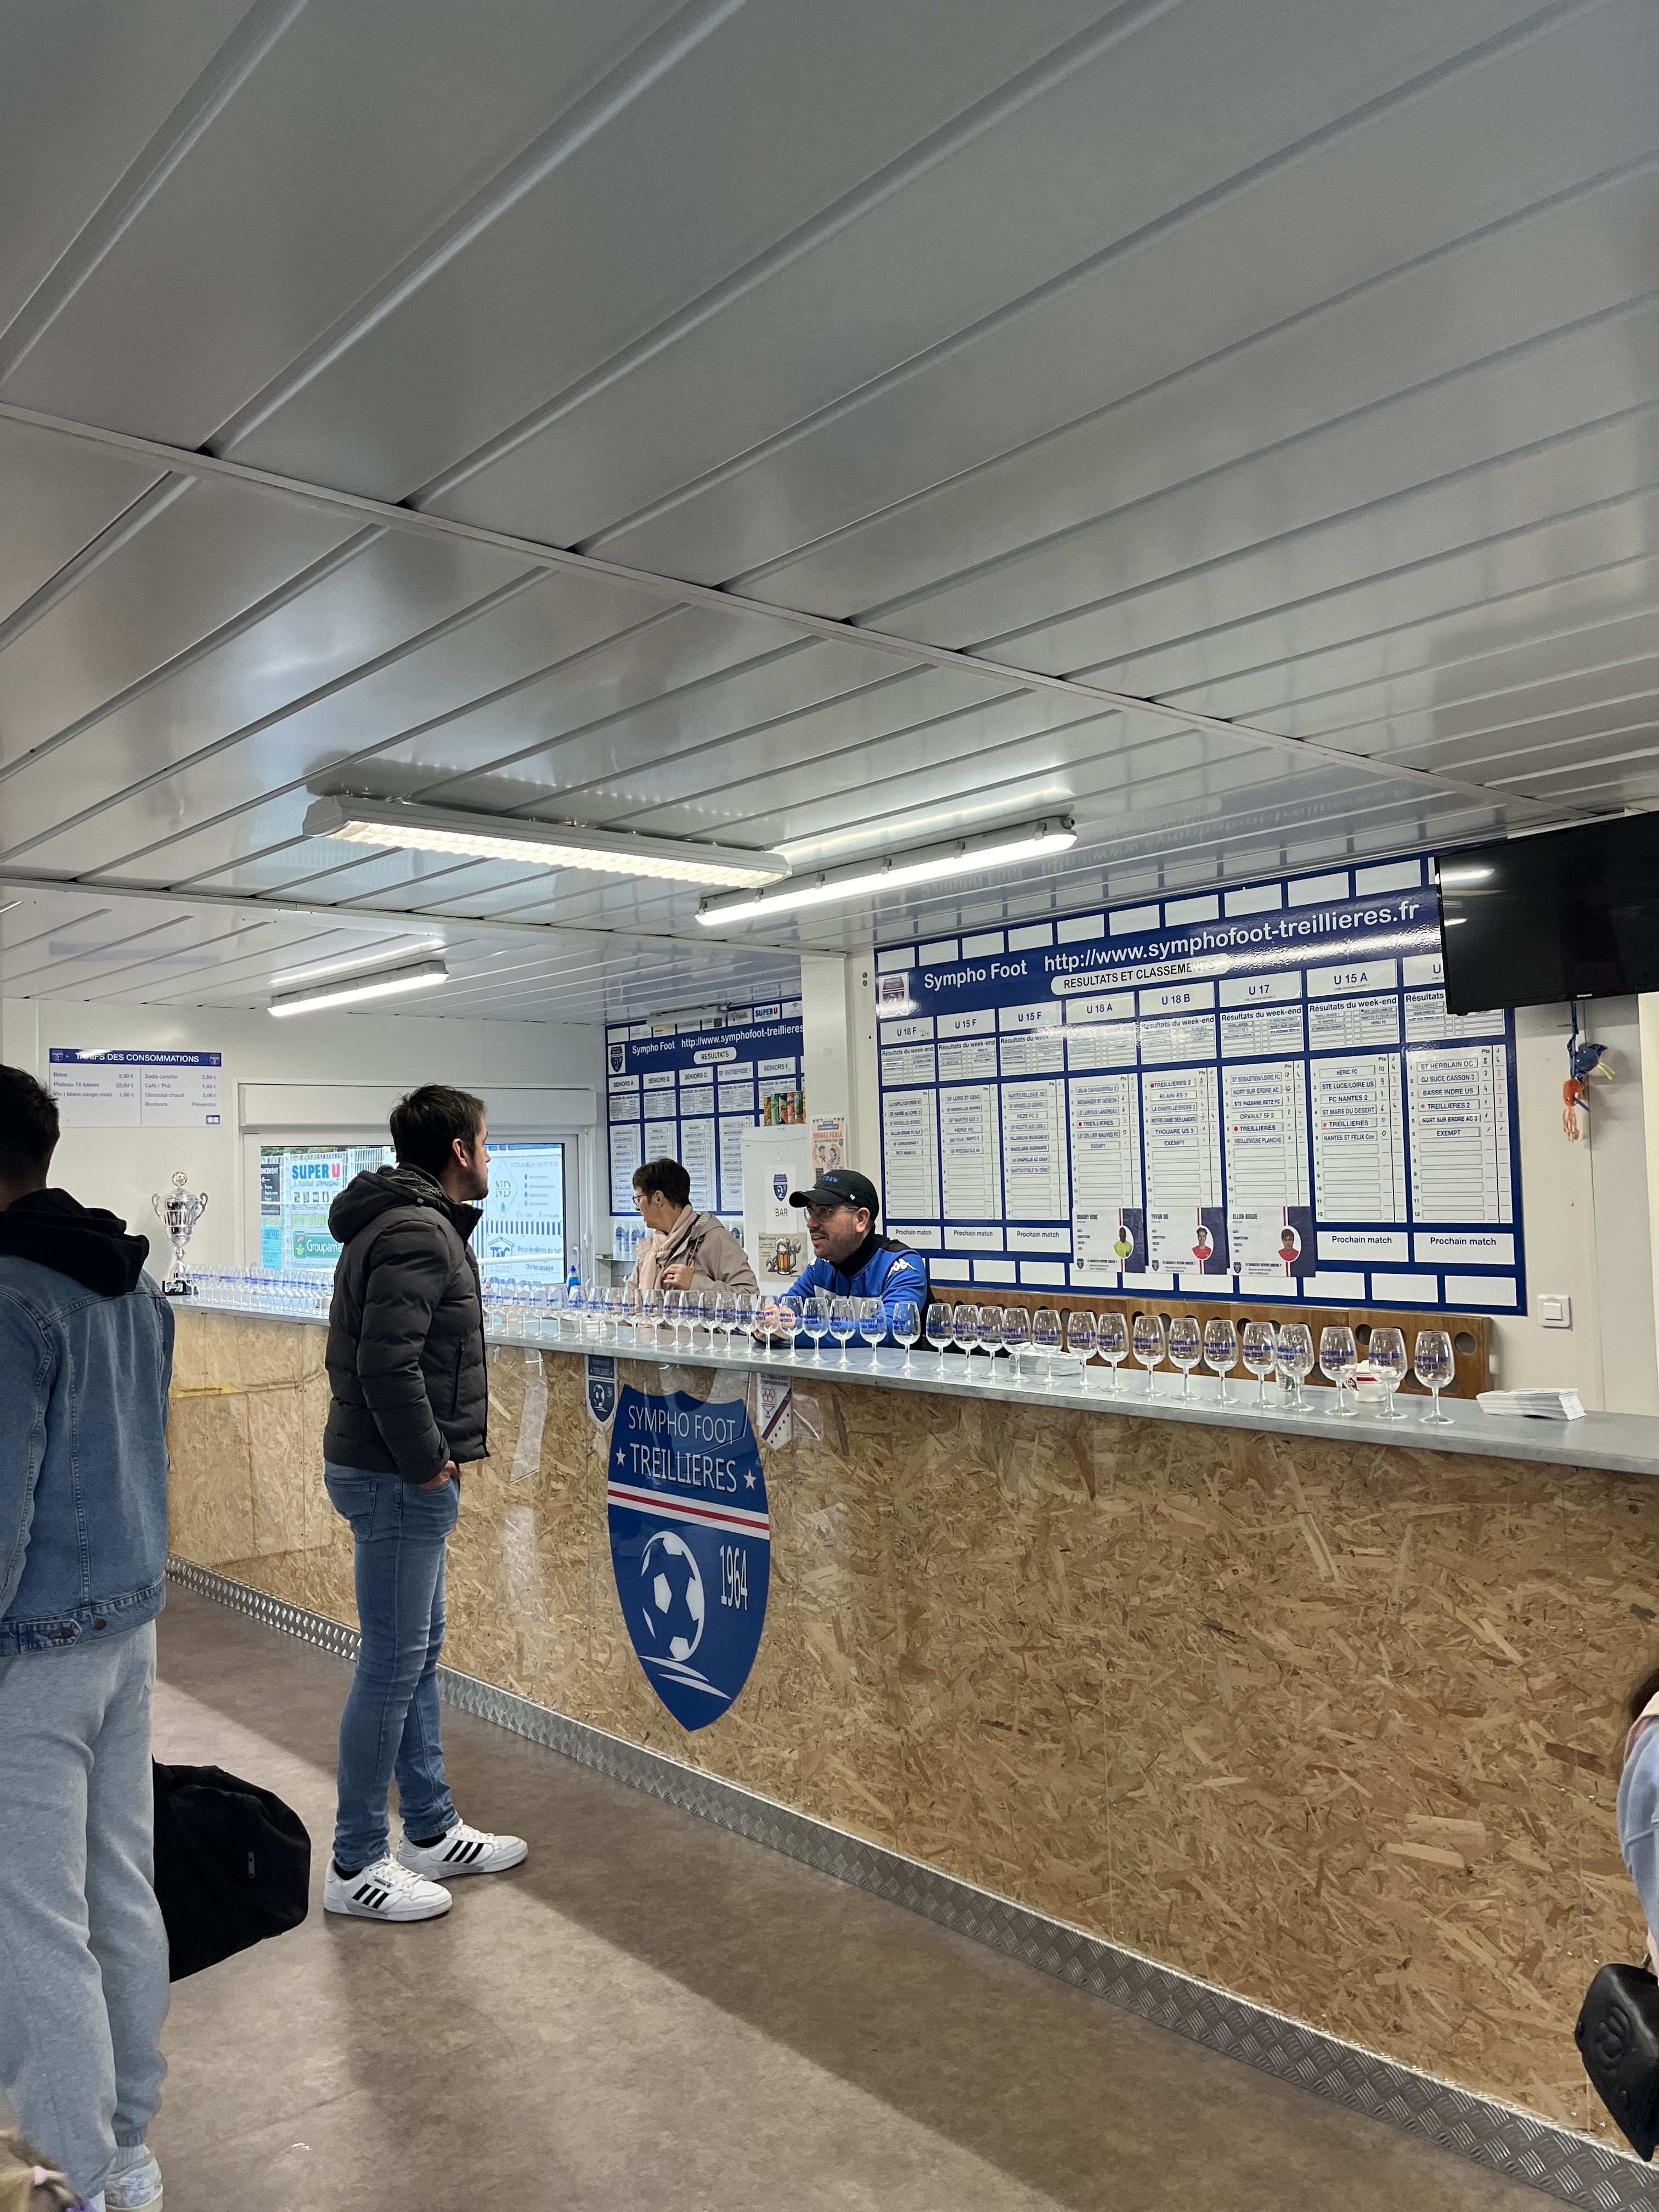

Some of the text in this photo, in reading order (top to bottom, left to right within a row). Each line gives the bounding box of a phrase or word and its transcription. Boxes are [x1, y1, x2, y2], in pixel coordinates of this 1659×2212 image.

[924, 900, 1420, 991] Sympho Foot http://www.symphofoot-treillieres.fr
[1064, 960, 1213, 989] RESULTATS ET CLASSEME
[1334, 973, 1367, 984] U 15 A
[1249, 985, 1269, 995] U 17
[1171, 995, 1181, 1003] 18
[1406, 993, 1444, 1002] Résultats
[1310, 1003, 1344, 1012] Résultats
[1358, 997, 1397, 1007] week-end
[755, 1008, 772, 1017] SUPER
[1266, 1007, 1301, 1016] week-end
[632, 1043, 658, 1056] Sympho
[660, 1041, 675, 1051] Foot
[126, 1054, 199, 1063] CONSOMMATIONS
[701, 1051, 729, 1060] RESULTATS
[292, 1164, 340, 1179] SUPER U
[775, 1209, 788, 1217] BAR
[307, 1239, 342, 1254] Groupama
[629, 1405, 736, 1444] SYMPHO FOOT
[630, 1443, 737, 1492] TREILLIERES
[720, 1545, 748, 1610] 1964
